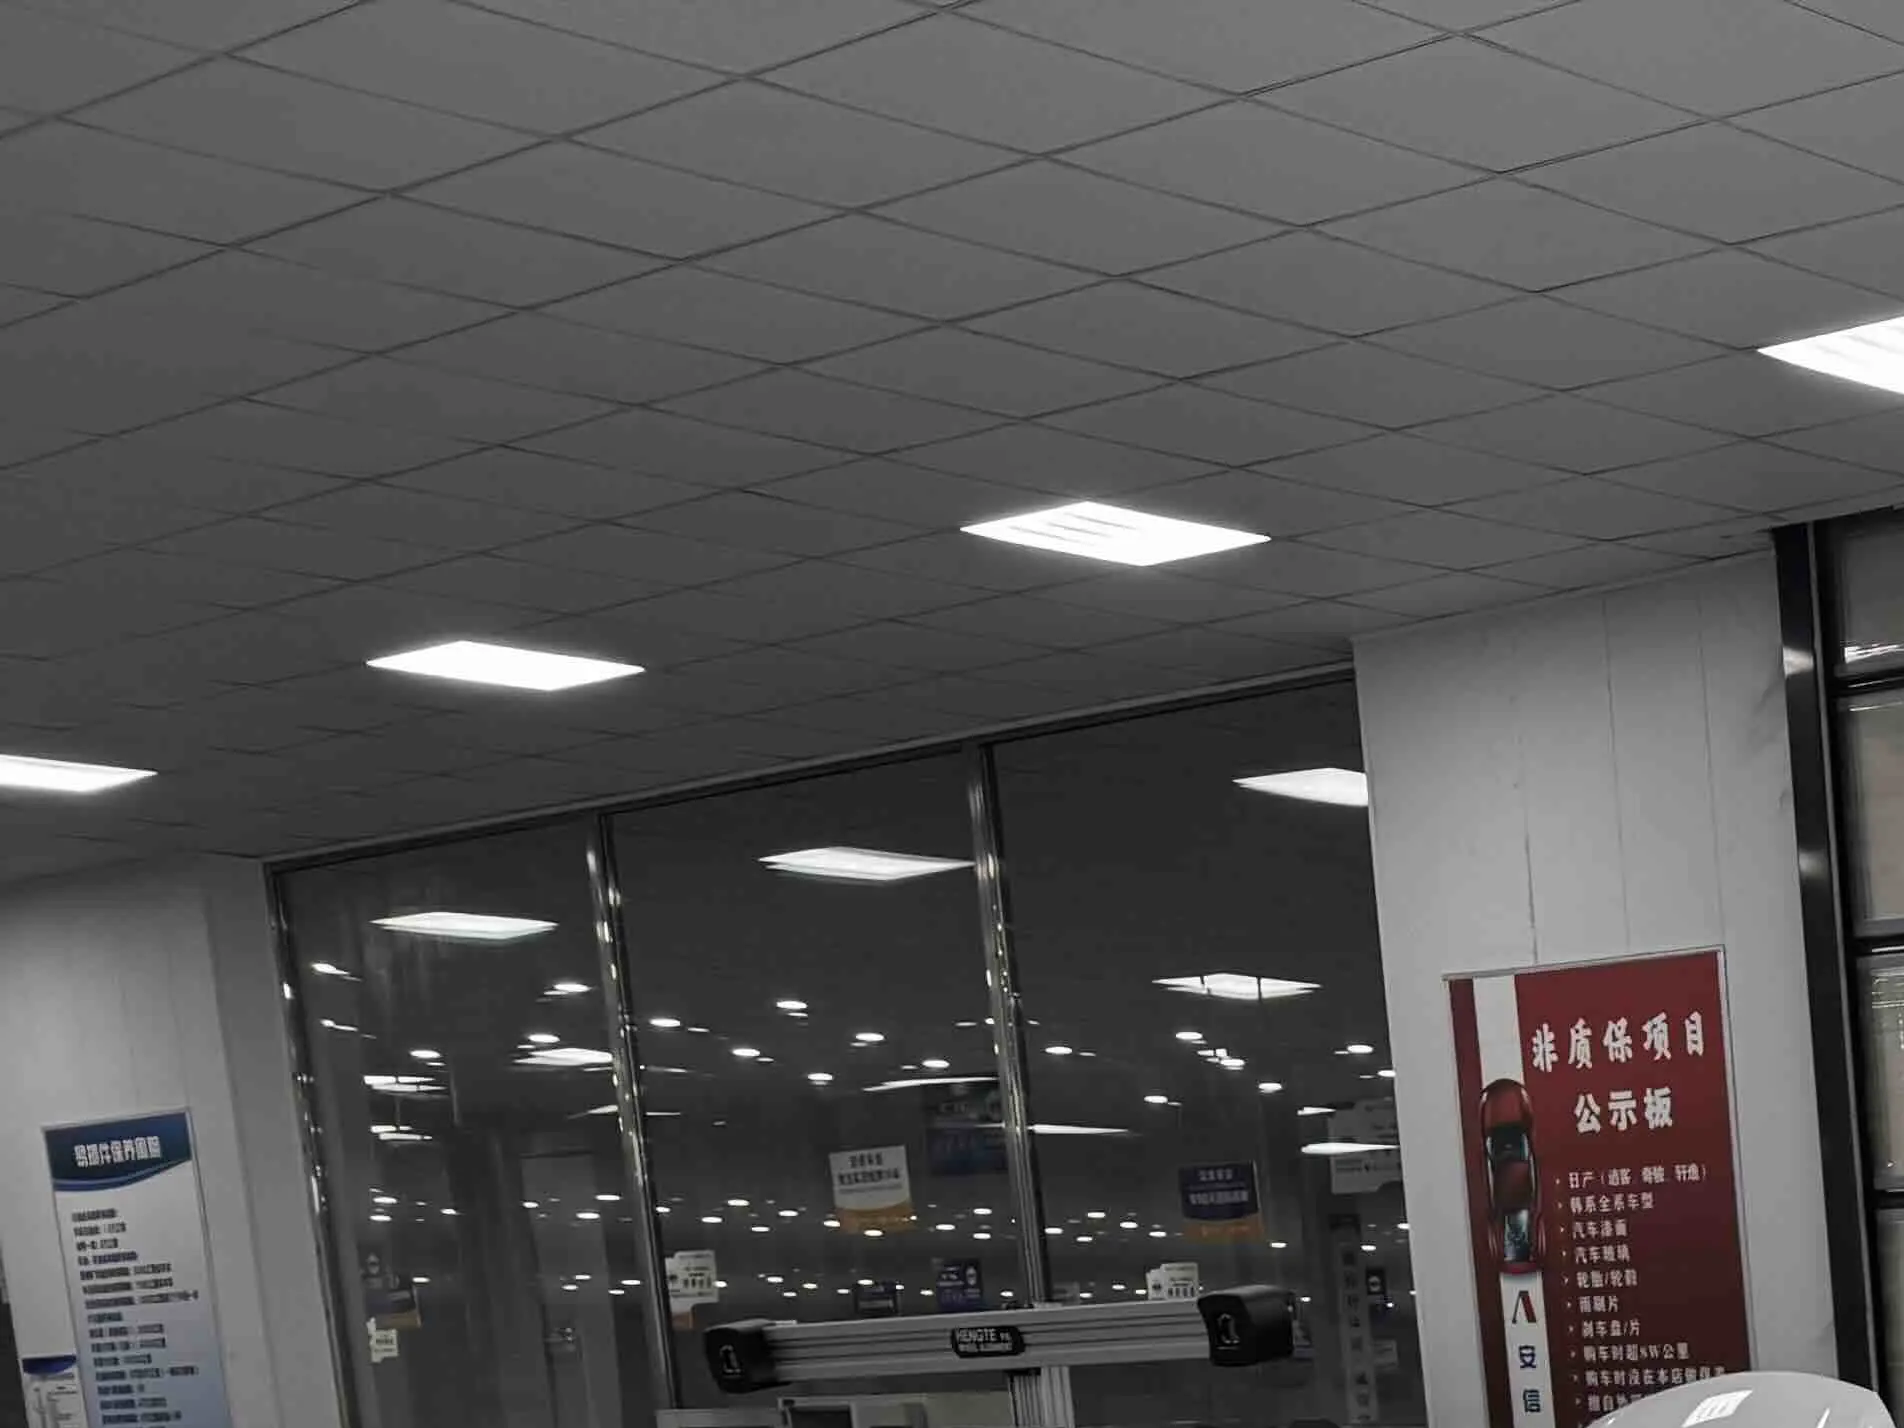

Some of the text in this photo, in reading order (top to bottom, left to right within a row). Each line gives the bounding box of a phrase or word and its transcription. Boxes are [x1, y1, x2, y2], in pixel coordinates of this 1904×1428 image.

[1531, 1011, 1704, 1073] 非质保项目
[1574, 1086, 1673, 1133] 公示板
[1570, 1191, 1654, 1215] 韩系全系车型
